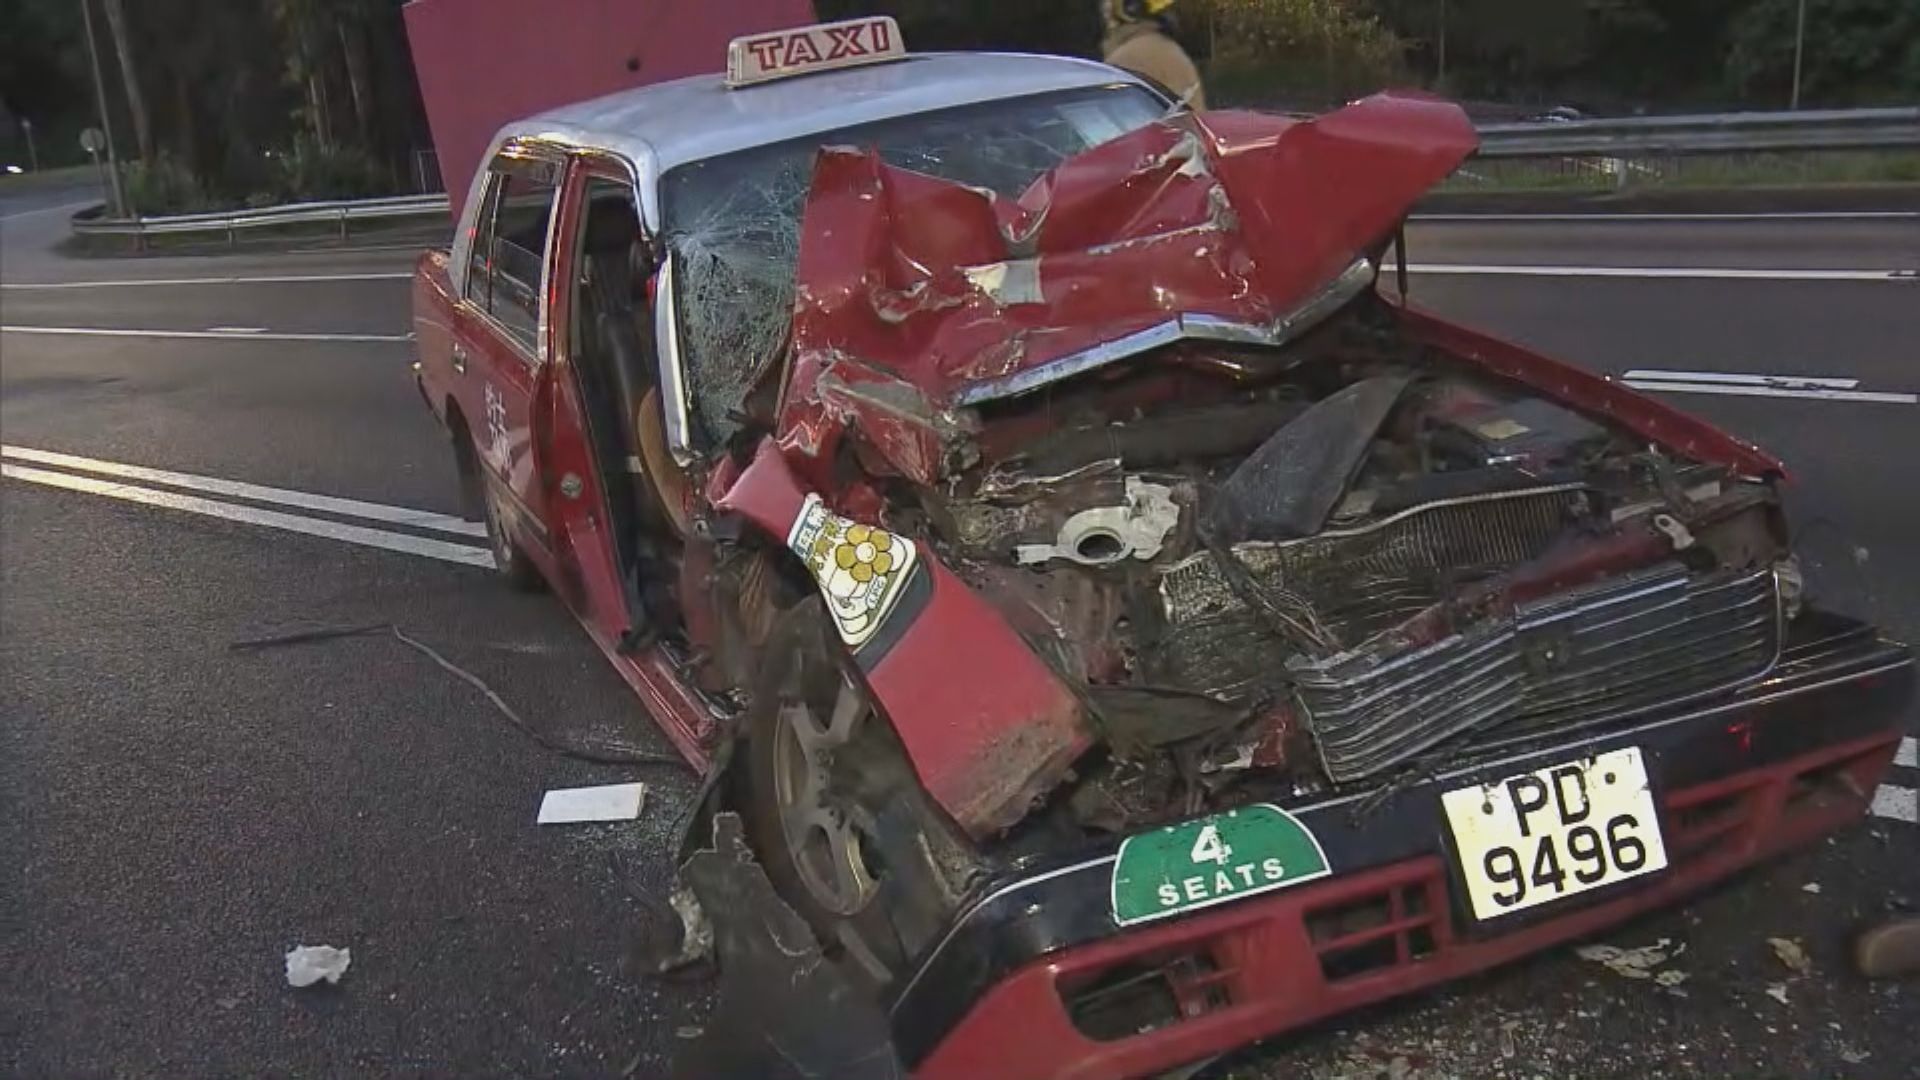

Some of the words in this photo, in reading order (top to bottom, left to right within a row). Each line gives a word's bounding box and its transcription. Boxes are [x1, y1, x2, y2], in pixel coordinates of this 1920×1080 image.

[747, 21, 891, 72] TAXI
[1505, 765, 1591, 838] PD
[1190, 824, 1233, 866] 4
[1483, 813, 1647, 907] 9496
[1157, 857, 1285, 906] SEATS
